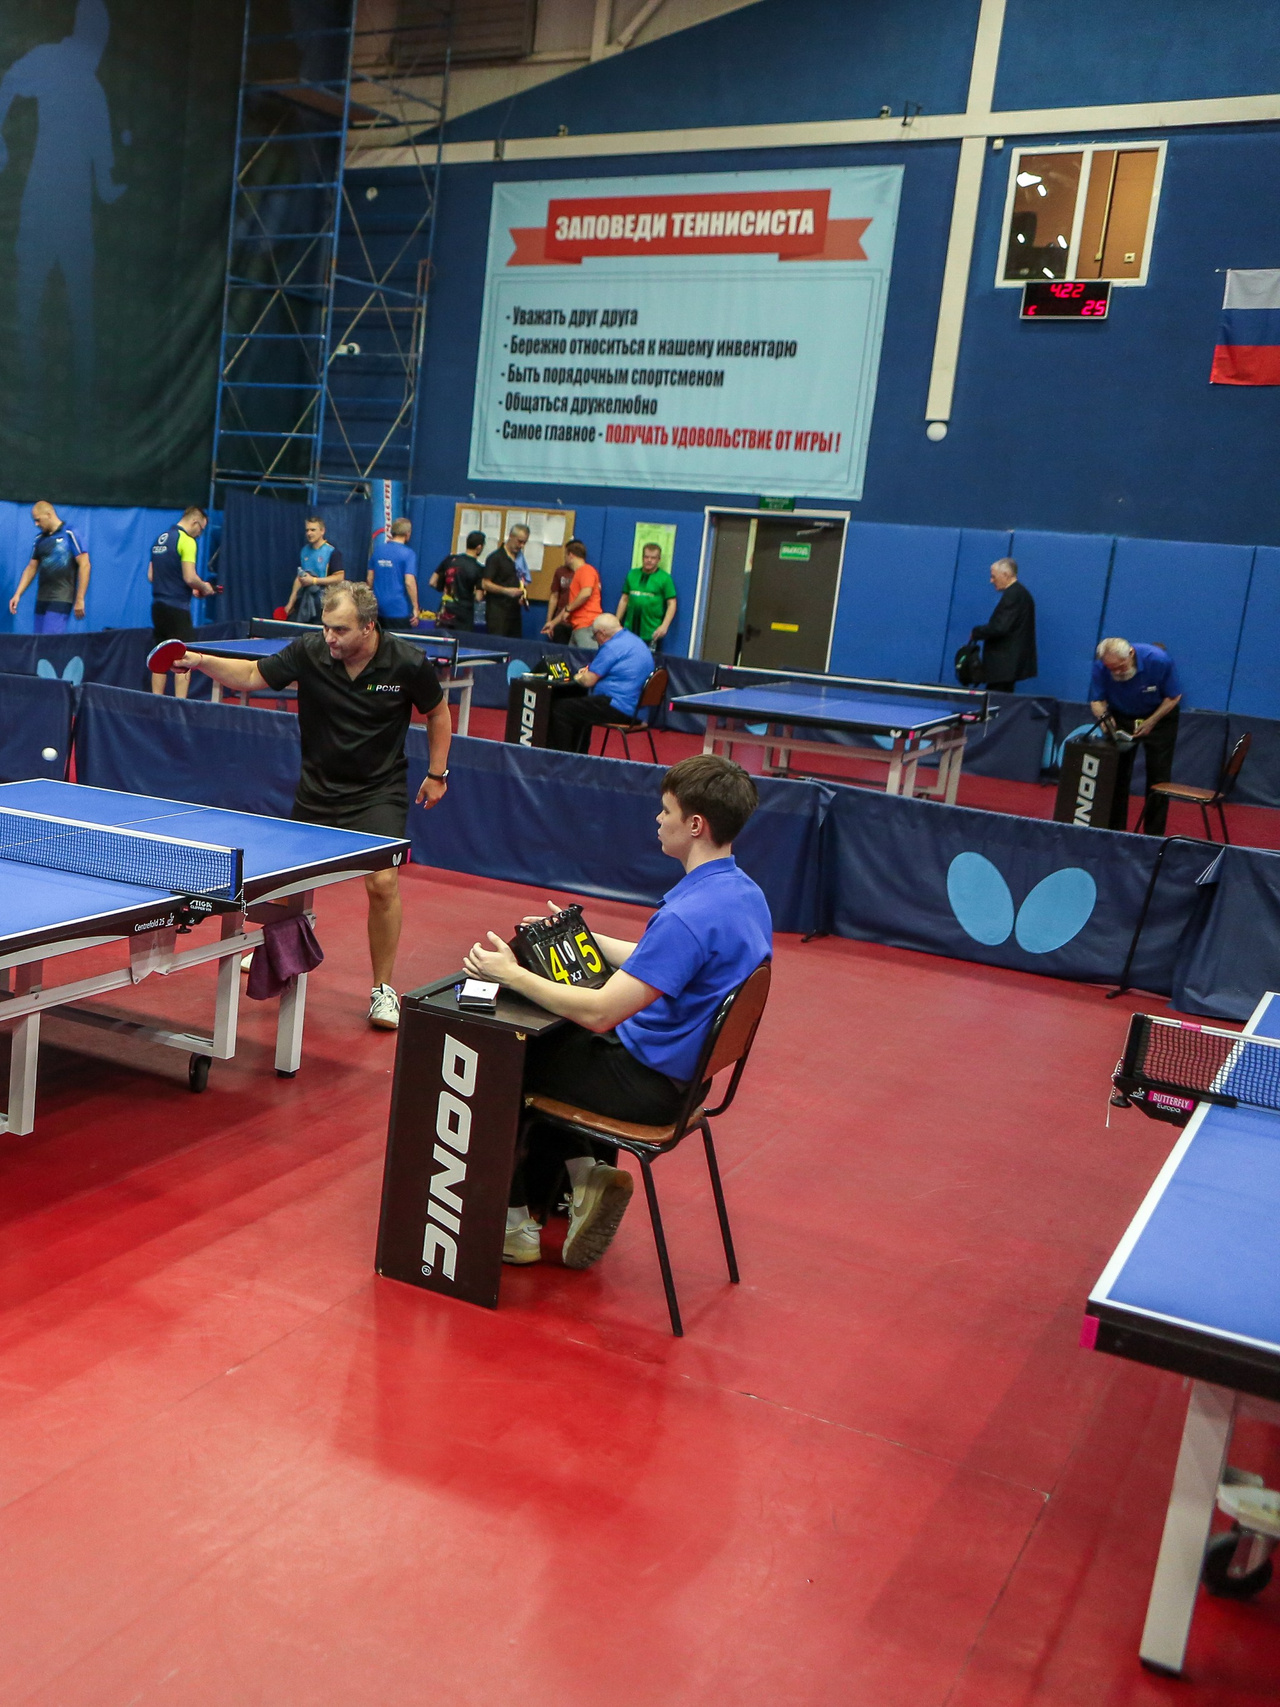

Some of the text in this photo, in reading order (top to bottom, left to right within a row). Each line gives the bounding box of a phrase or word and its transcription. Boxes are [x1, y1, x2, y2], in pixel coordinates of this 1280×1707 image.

[555, 208, 815, 243] ЗАПОВЕДИ ТЕННИСИСТА
[513, 305, 638, 328] Уважать друг друга
[1081, 300, 1107, 315] 25
[510, 335, 798, 360] Бережно относиться к нашему инвентарю
[507, 363, 725, 388] Быть порядочным спортсменом
[505, 391, 658, 416] Общаться дружелюбно
[502, 419, 542, 440] Самое
[544, 424, 596, 443] главное
[605, 423, 669, 446] ПОЛУЧАТЬ
[671, 426, 773, 450] УДОВОЛЬСТВИЕ
[775, 429, 793, 451] ОТ
[794, 430, 833, 453] ИГРЫ
[520, 688, 537, 747] DON
[1073, 753, 1101, 827] DONI
[134, 918, 159, 932] Centrefold
[574, 931, 602, 974] 5
[1152, 1092, 1190, 1109] BUTTERFLY
[1156, 1102, 1181, 1113] Europa
[422, 1033, 479, 1283] DONIC
